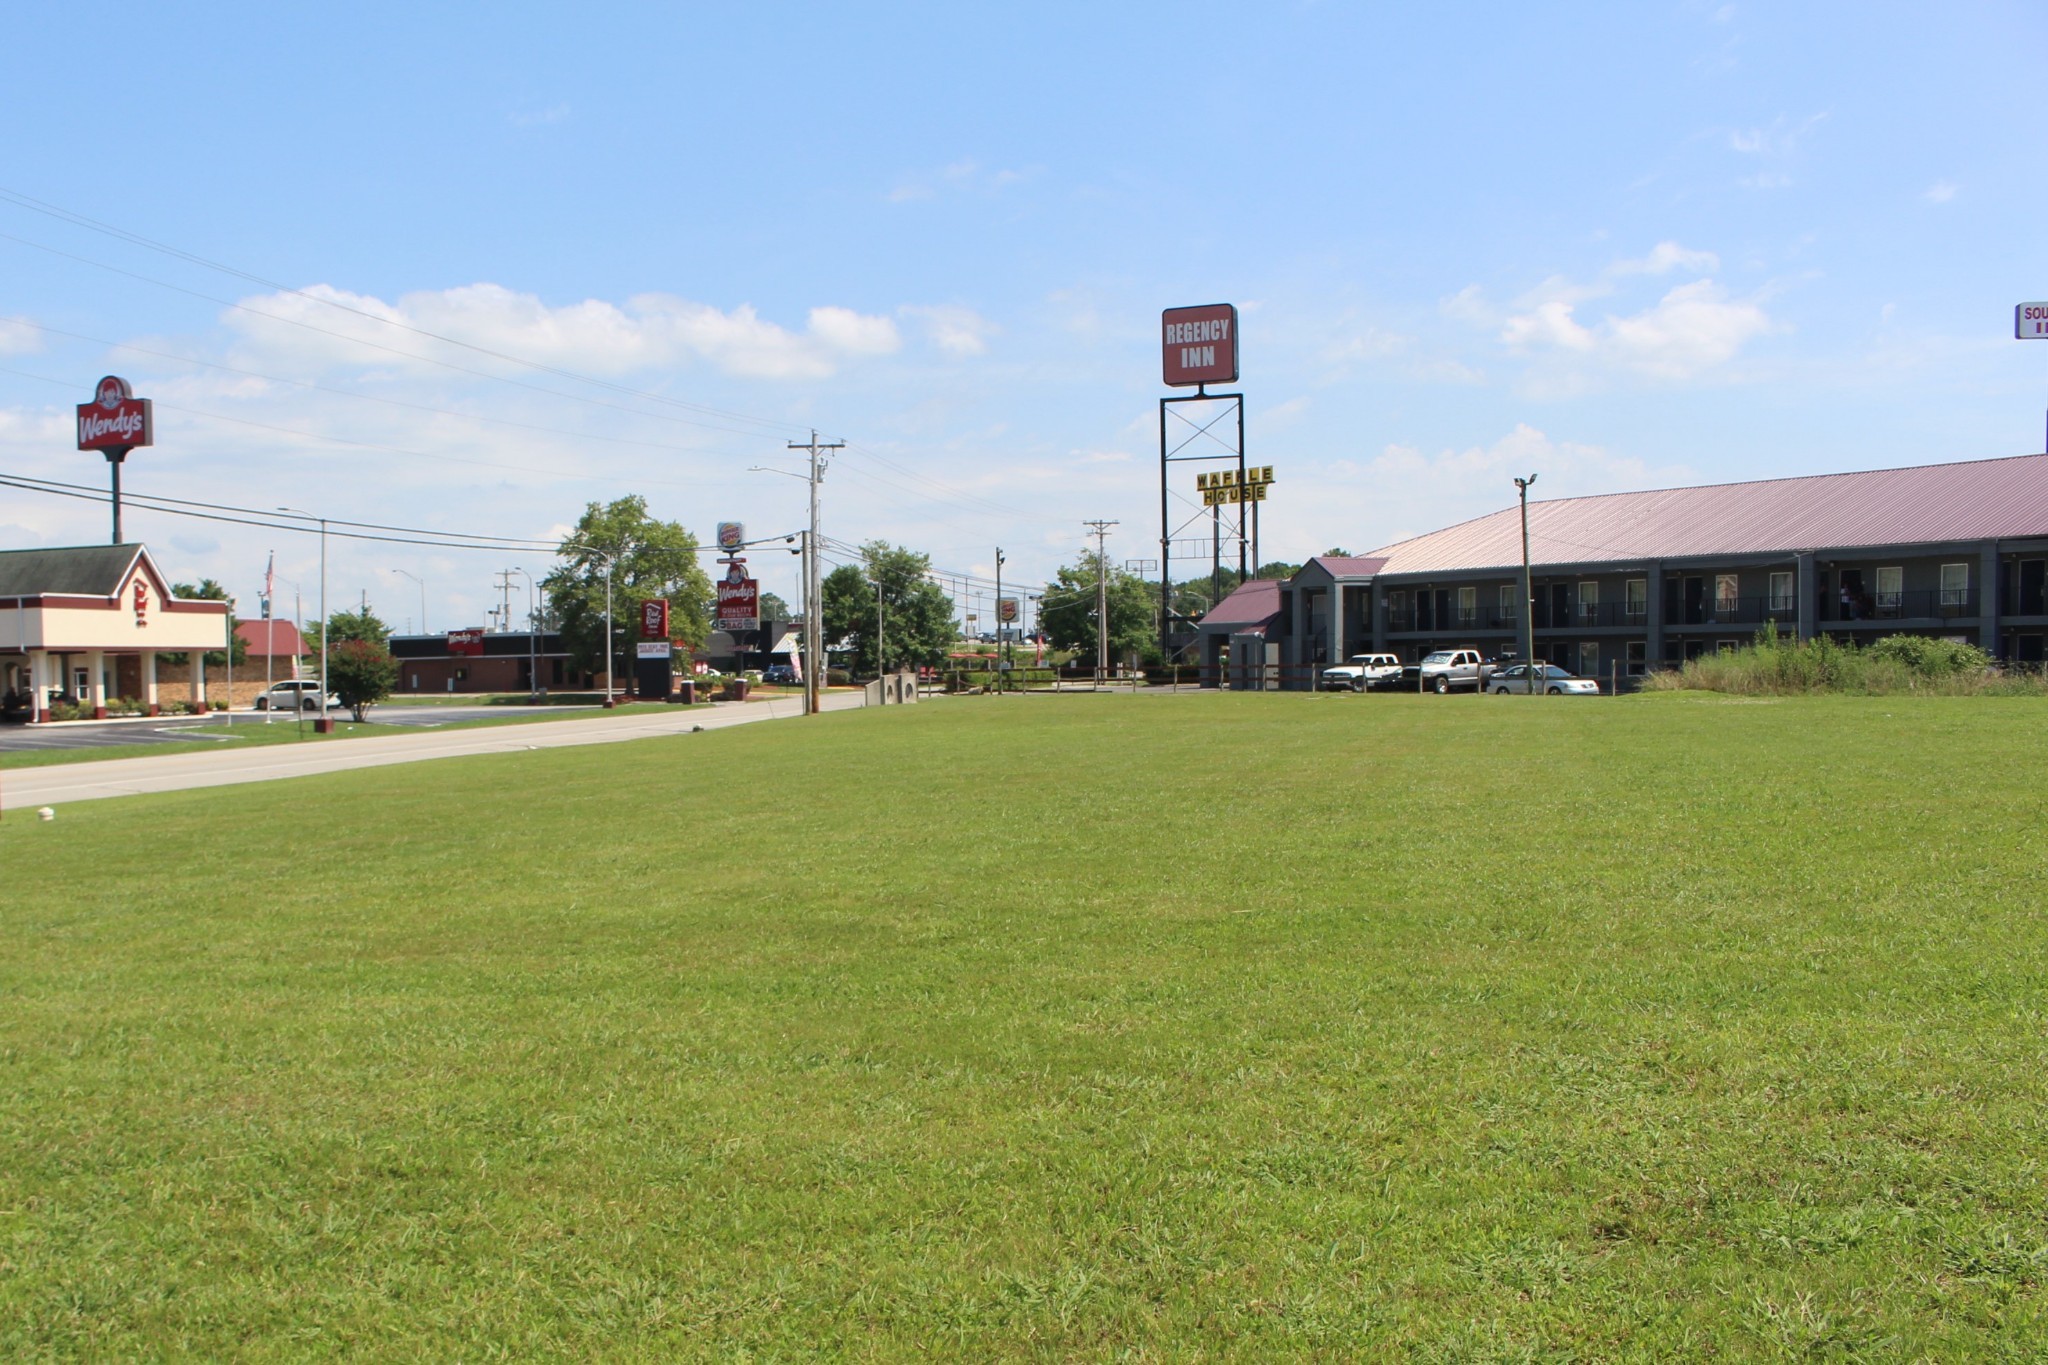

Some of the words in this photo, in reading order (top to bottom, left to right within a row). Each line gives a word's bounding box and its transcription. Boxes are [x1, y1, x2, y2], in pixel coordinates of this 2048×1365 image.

[1166, 319, 1230, 345] REGENCY
[2036, 322, 2048, 334] I
[1181, 346, 1215, 368] INN
[80, 407, 143, 443] Wendy's
[1204, 486, 1264, 503] HOUSE
[719, 583, 755, 602] Wendy's
[721, 606, 752, 615] QUALITY
